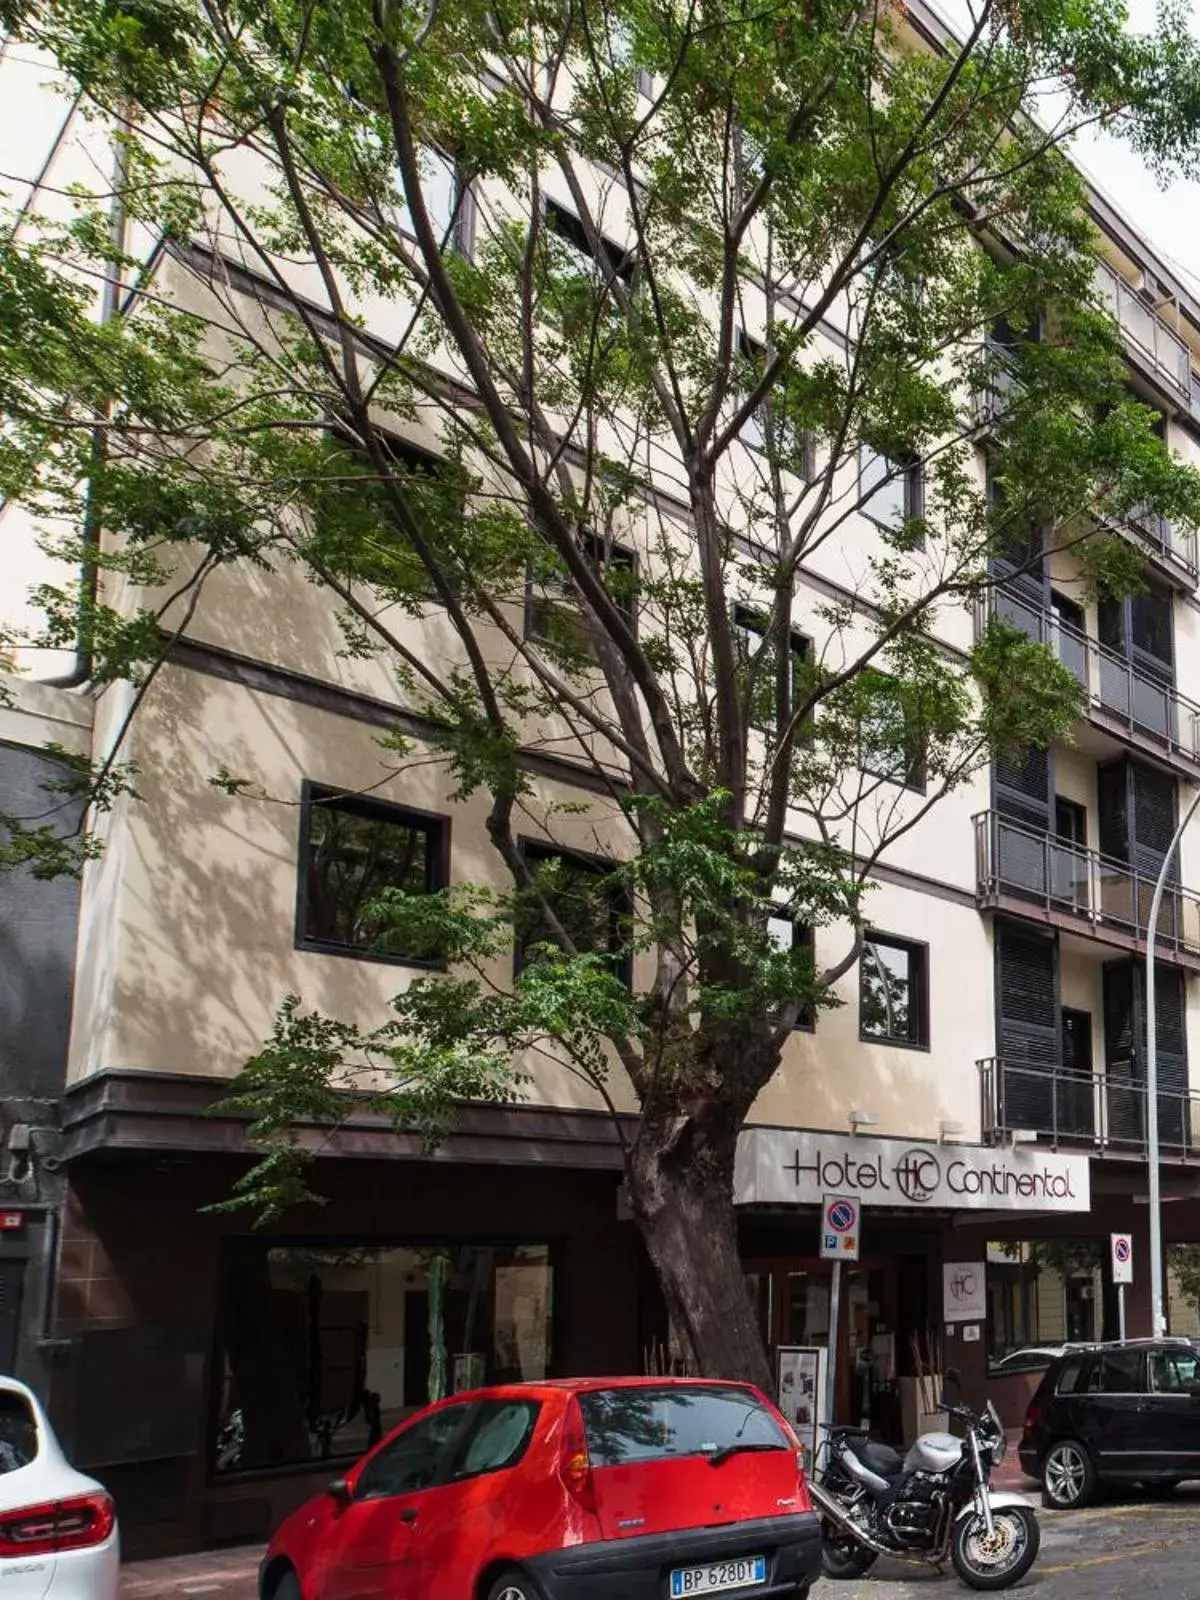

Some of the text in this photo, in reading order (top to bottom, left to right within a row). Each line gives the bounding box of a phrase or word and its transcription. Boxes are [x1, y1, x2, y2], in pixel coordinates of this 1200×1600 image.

[783, 1149, 889, 1190] Hotel
[947, 1160, 1076, 1198] Continental
[684, 1571, 703, 1590] BP
